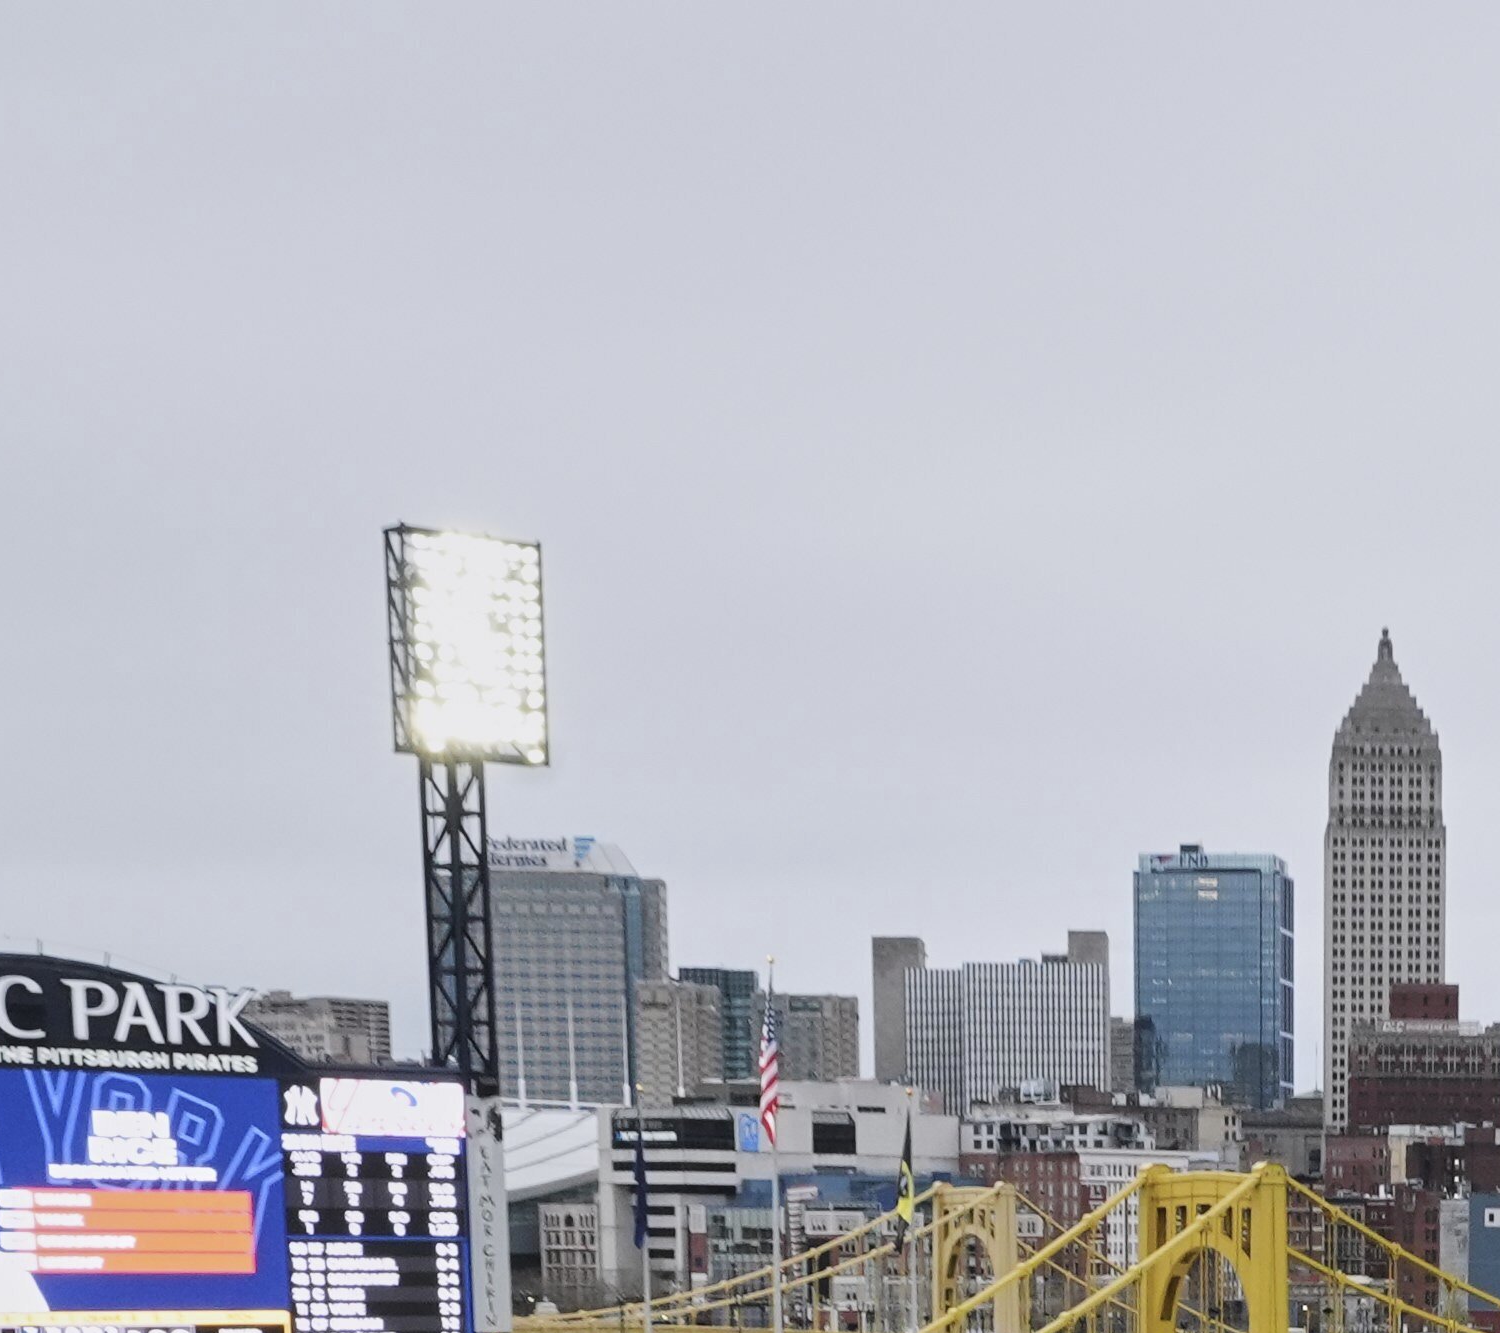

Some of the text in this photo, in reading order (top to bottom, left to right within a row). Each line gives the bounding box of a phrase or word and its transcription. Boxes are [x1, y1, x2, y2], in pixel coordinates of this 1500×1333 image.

[60, 976, 260, 1048] PARK
[36, 1045, 170, 1071] PITTSBURGH
[171, 1050, 258, 1074] PIRATES
[91, 1110, 170, 1139] BEN
